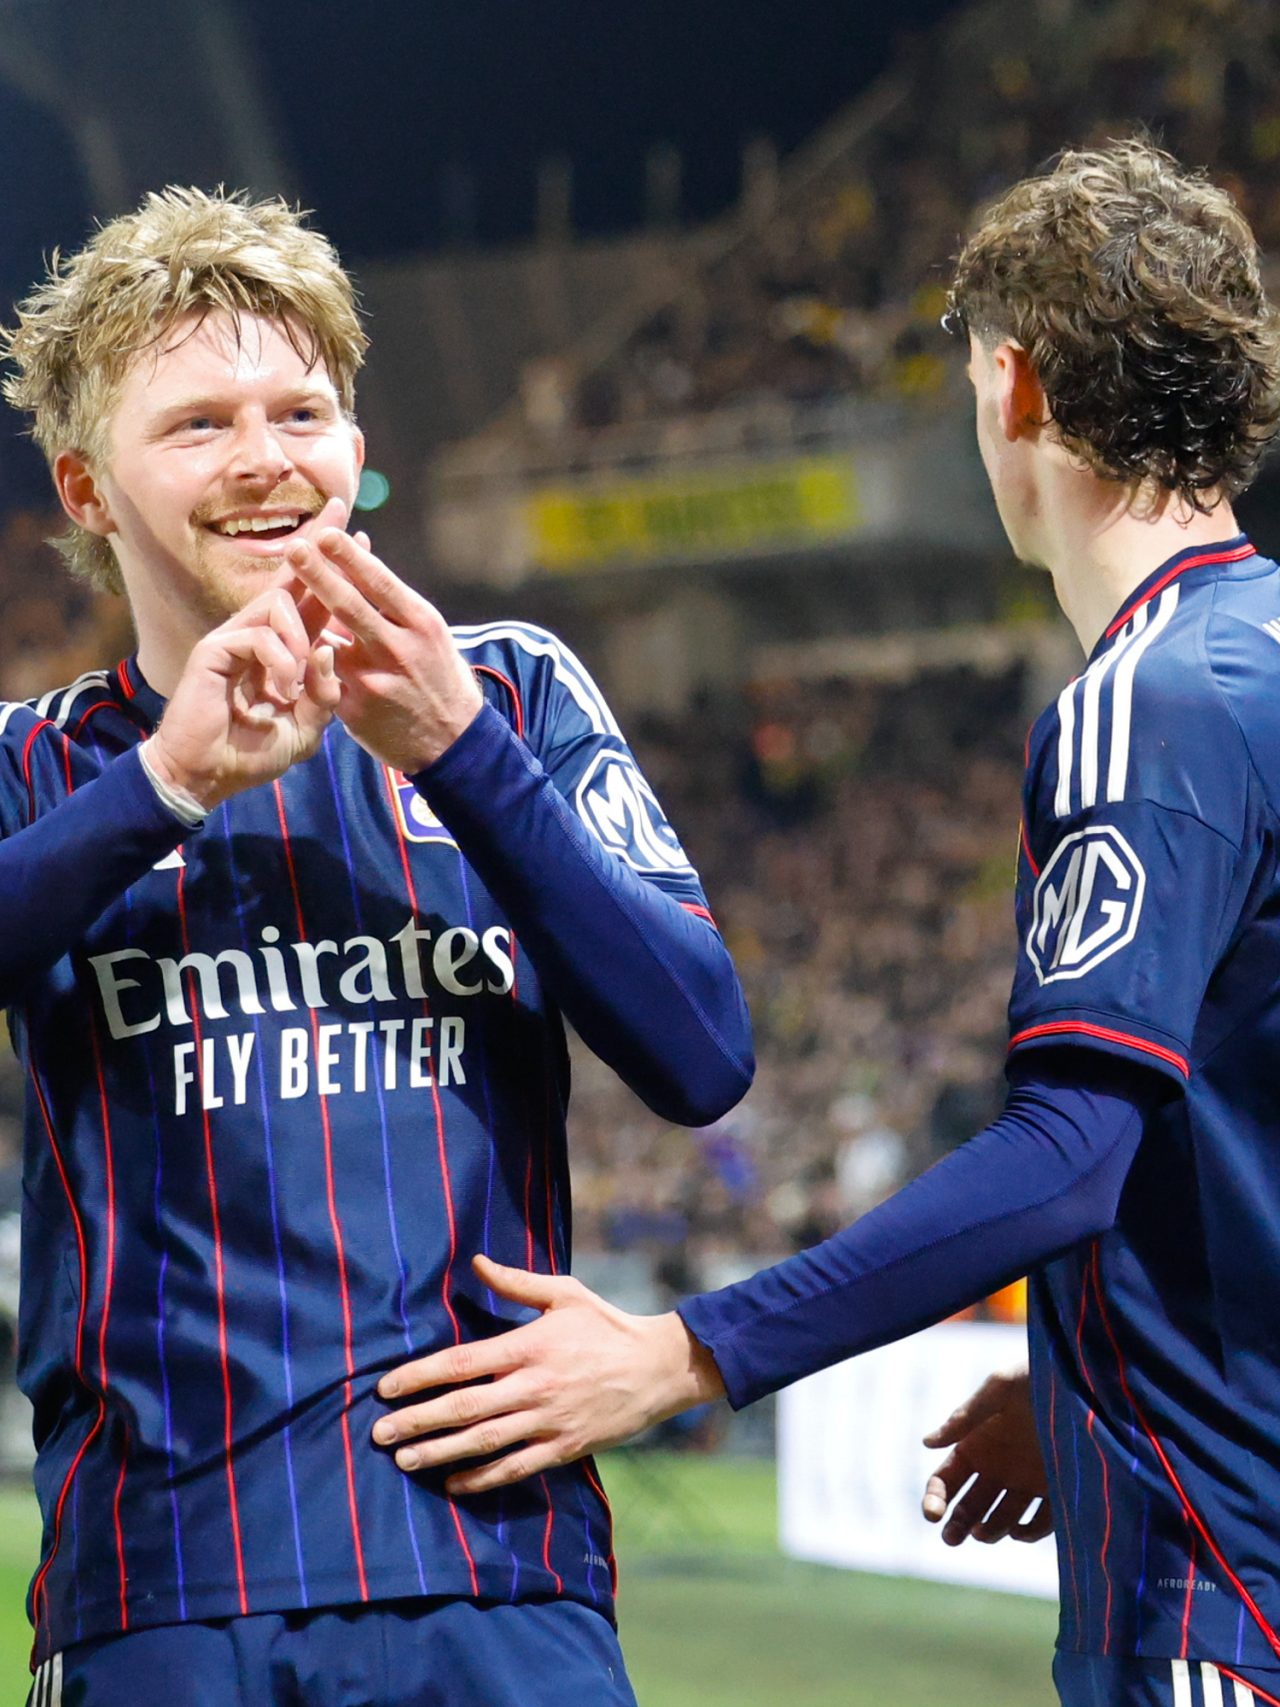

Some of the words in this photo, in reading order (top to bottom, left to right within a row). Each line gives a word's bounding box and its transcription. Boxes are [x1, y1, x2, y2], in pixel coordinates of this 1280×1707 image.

[1036, 840, 1132, 971] MG
[87, 915, 516, 1041] Emirates
[173, 1032, 256, 1116] FLY
[279, 1015, 467, 1100] BETTER
